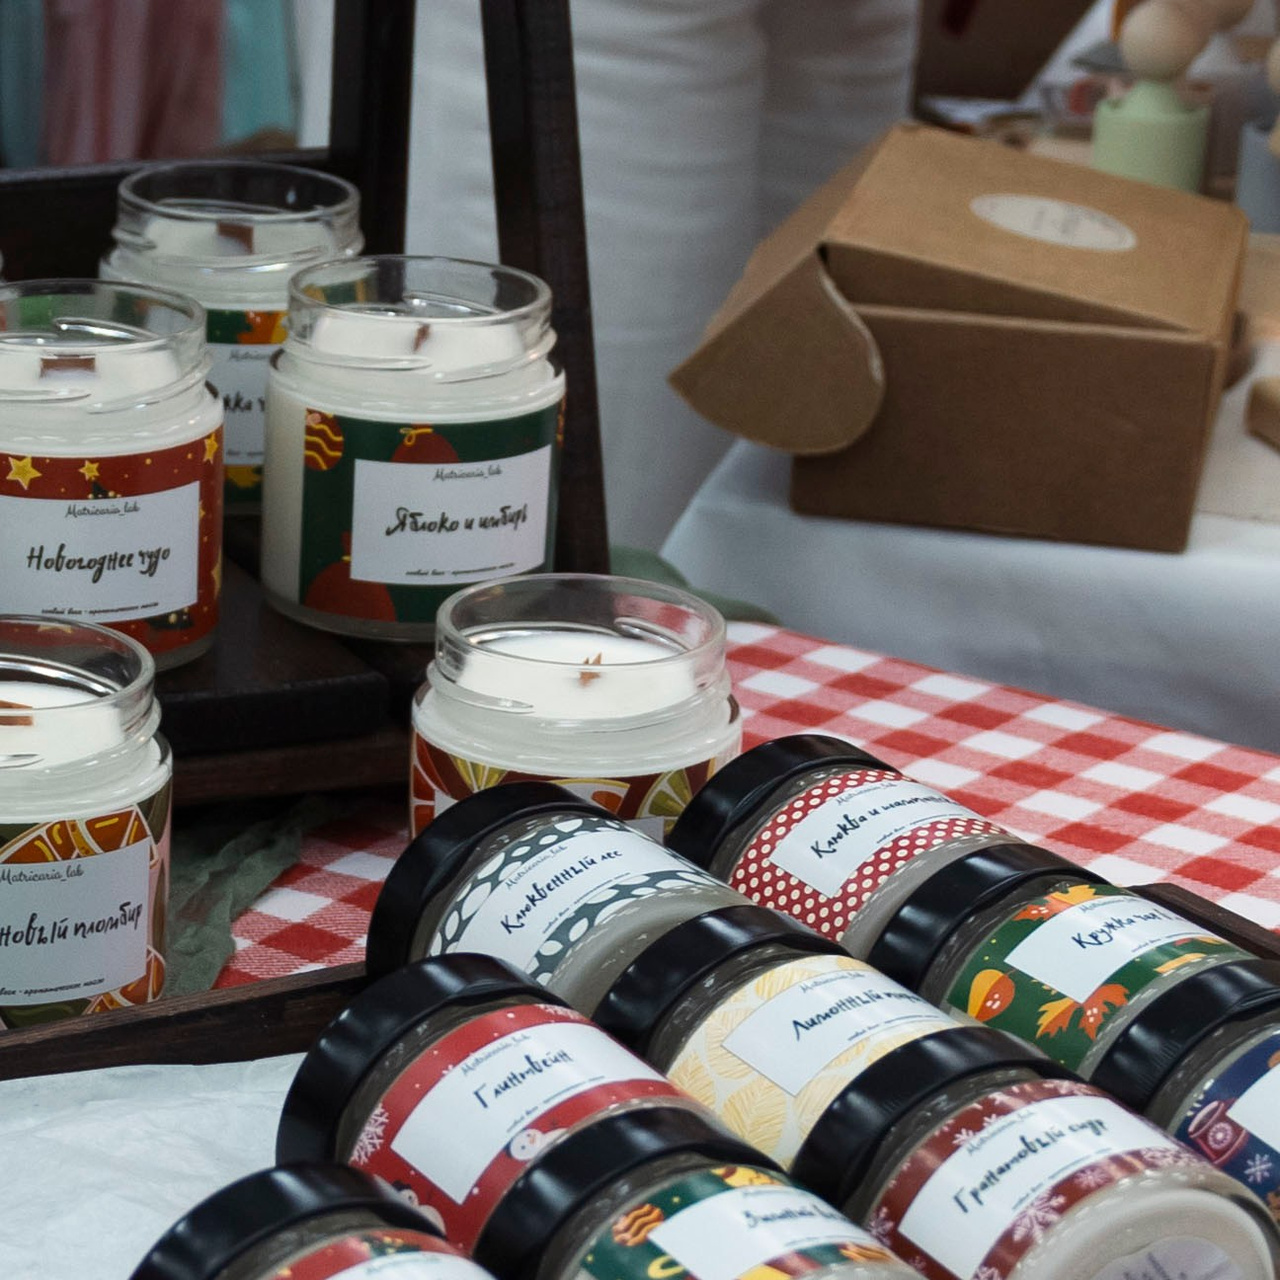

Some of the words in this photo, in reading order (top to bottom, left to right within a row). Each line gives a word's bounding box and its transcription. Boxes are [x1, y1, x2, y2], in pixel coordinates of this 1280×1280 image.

[64, 501, 141, 519] Matricaria_lab
[385, 506, 460, 536] Яблоко
[463, 517, 474, 531] и
[26, 543, 135, 584] Новогоднее
[138, 546, 171, 577] чудо
[810, 812, 869, 859] Клюква
[868, 807, 881, 818] и
[499, 854, 598, 935] Клюквенный
[600, 849, 624, 862] лес
[72, 900, 144, 939] пломбир
[1070, 915, 1136, 949] Кружка
[791, 989, 883, 1042] Лимонный
[472, 1047, 575, 1110] Глинтвейн
[952, 1126, 1066, 1214] Гранатовый
